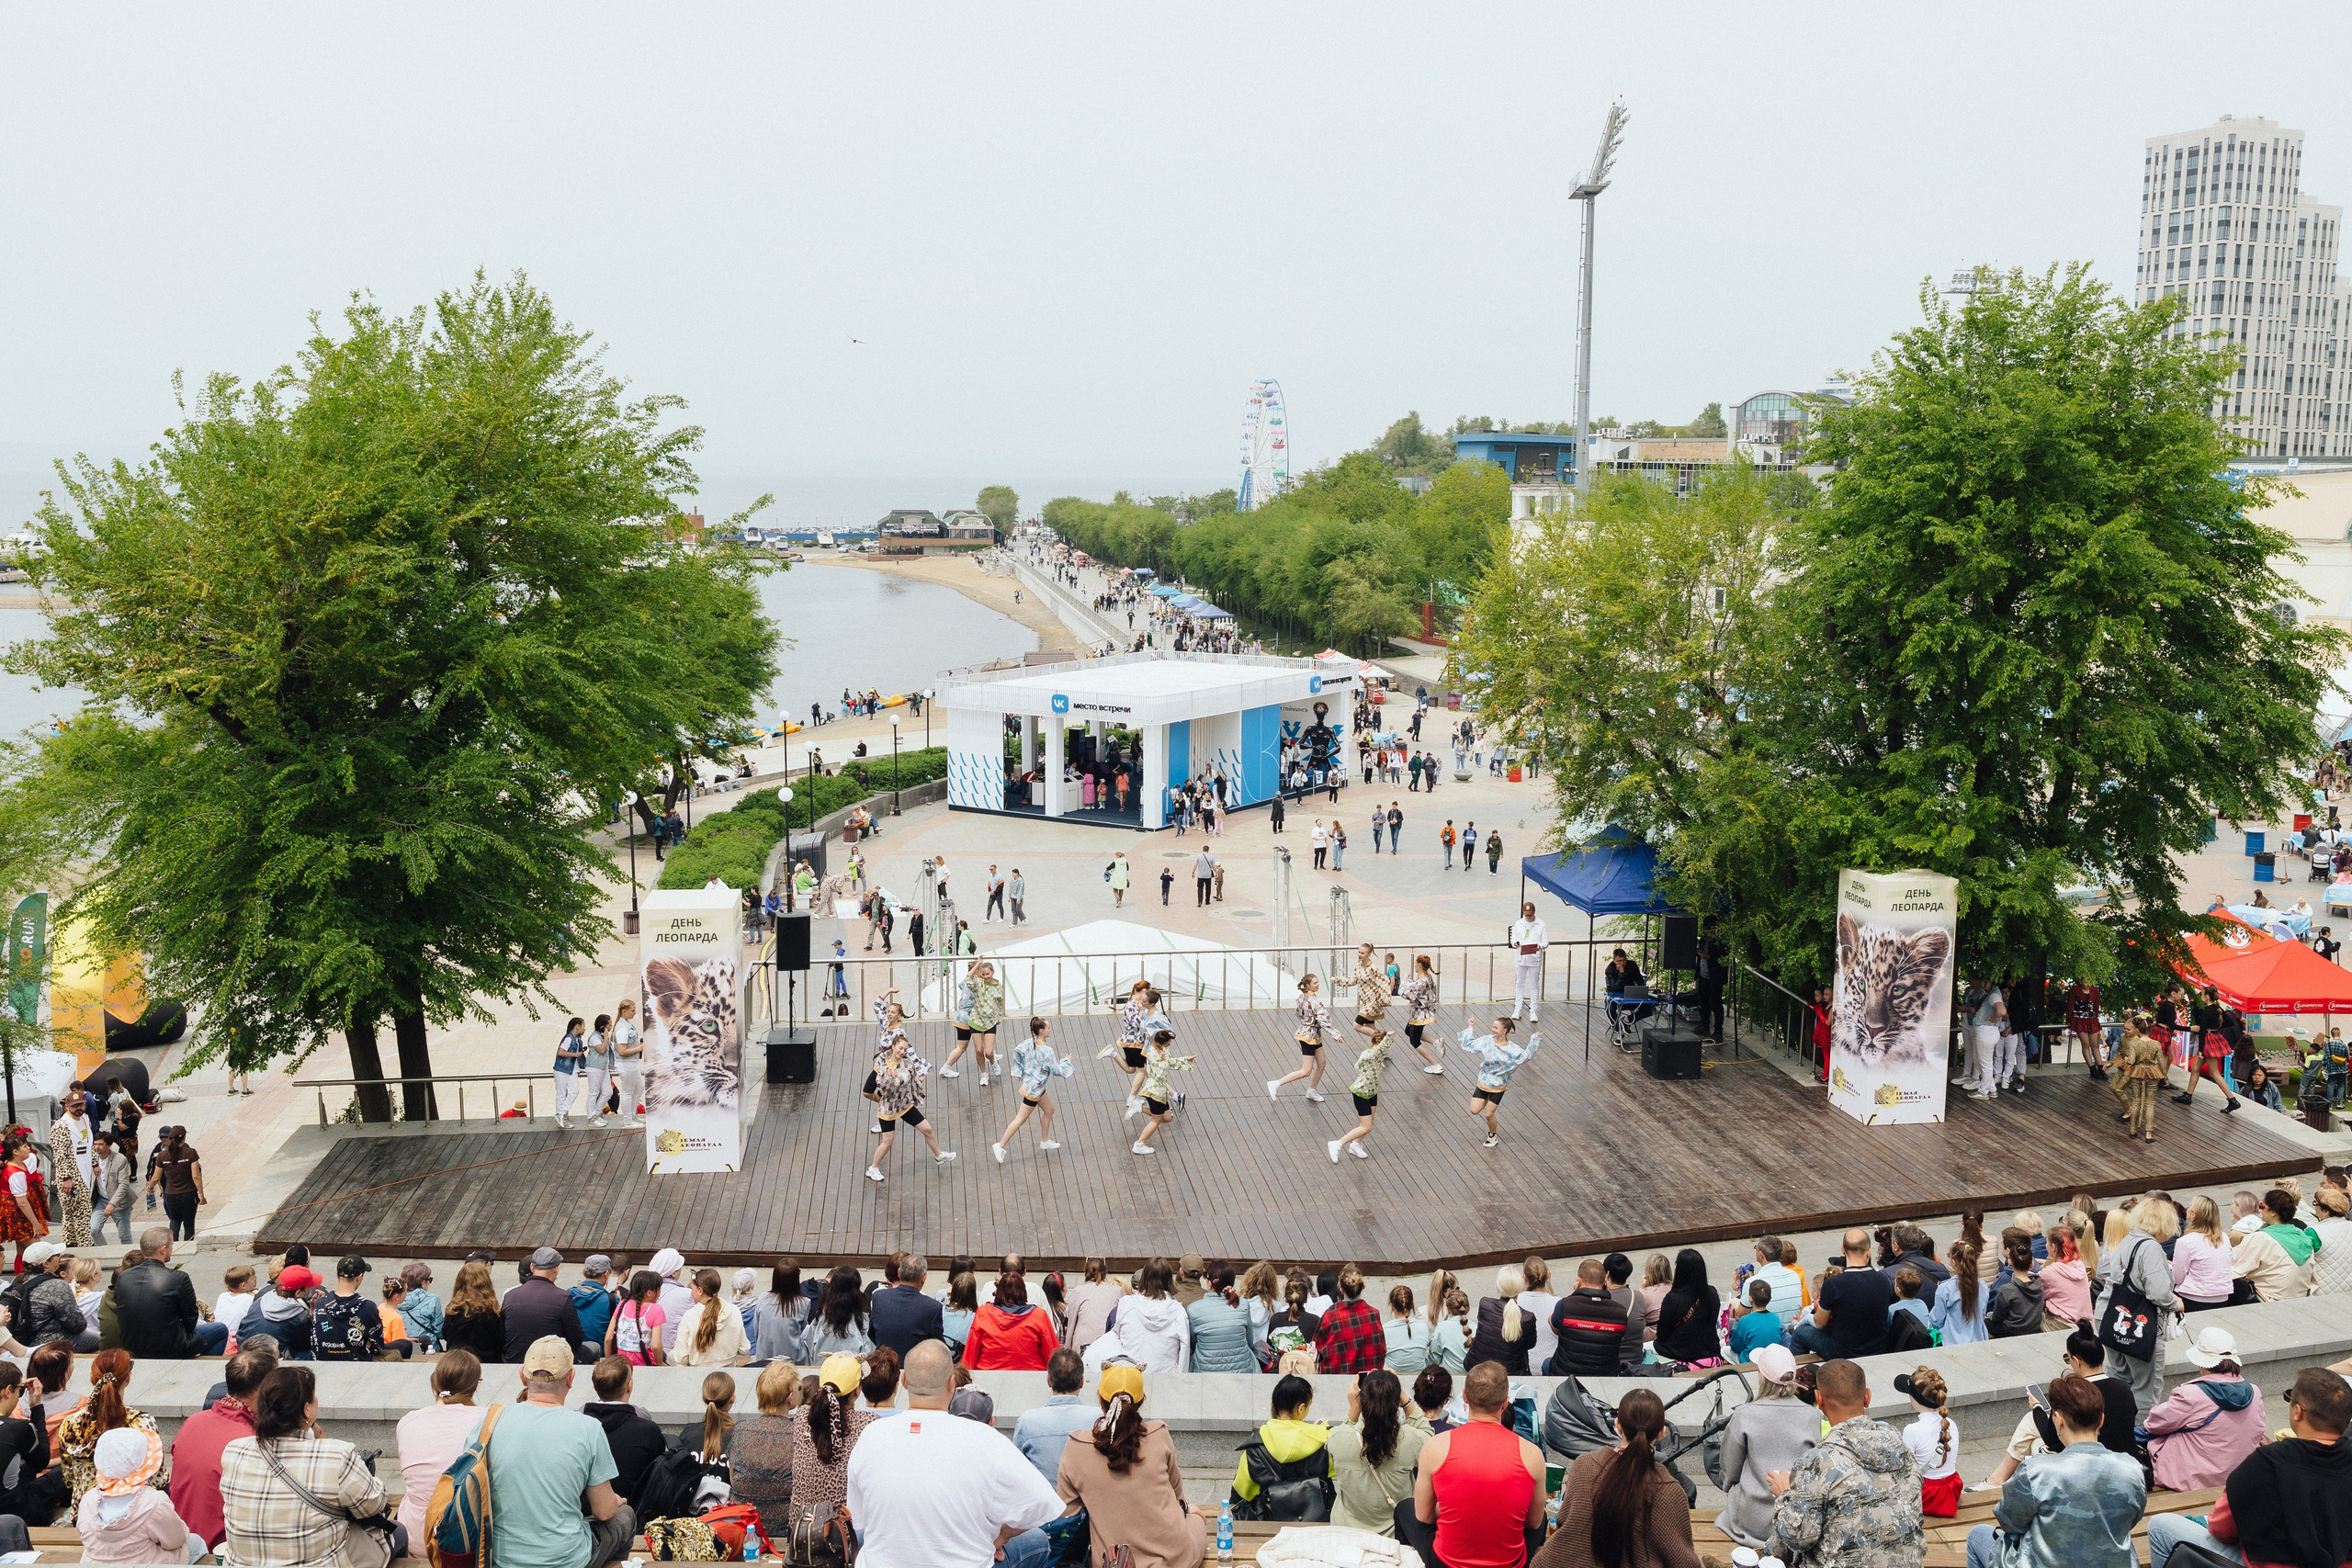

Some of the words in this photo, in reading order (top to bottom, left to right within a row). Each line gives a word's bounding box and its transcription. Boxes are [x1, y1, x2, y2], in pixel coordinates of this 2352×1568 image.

[1054, 699, 1064, 709] VK
[1098, 705, 1131, 713] встречи
[1851, 881, 1866, 892] ДЕНЬ
[1905, 889, 1931, 899] ДЕНЬ
[1845, 891, 1871, 908] ЛЕОПАРДА
[1891, 902, 1944, 912] ЛЕОПАРДА
[671, 919, 701, 929] ДЕНЬ
[656, 933, 718, 943] ЛЕОПАРДА
